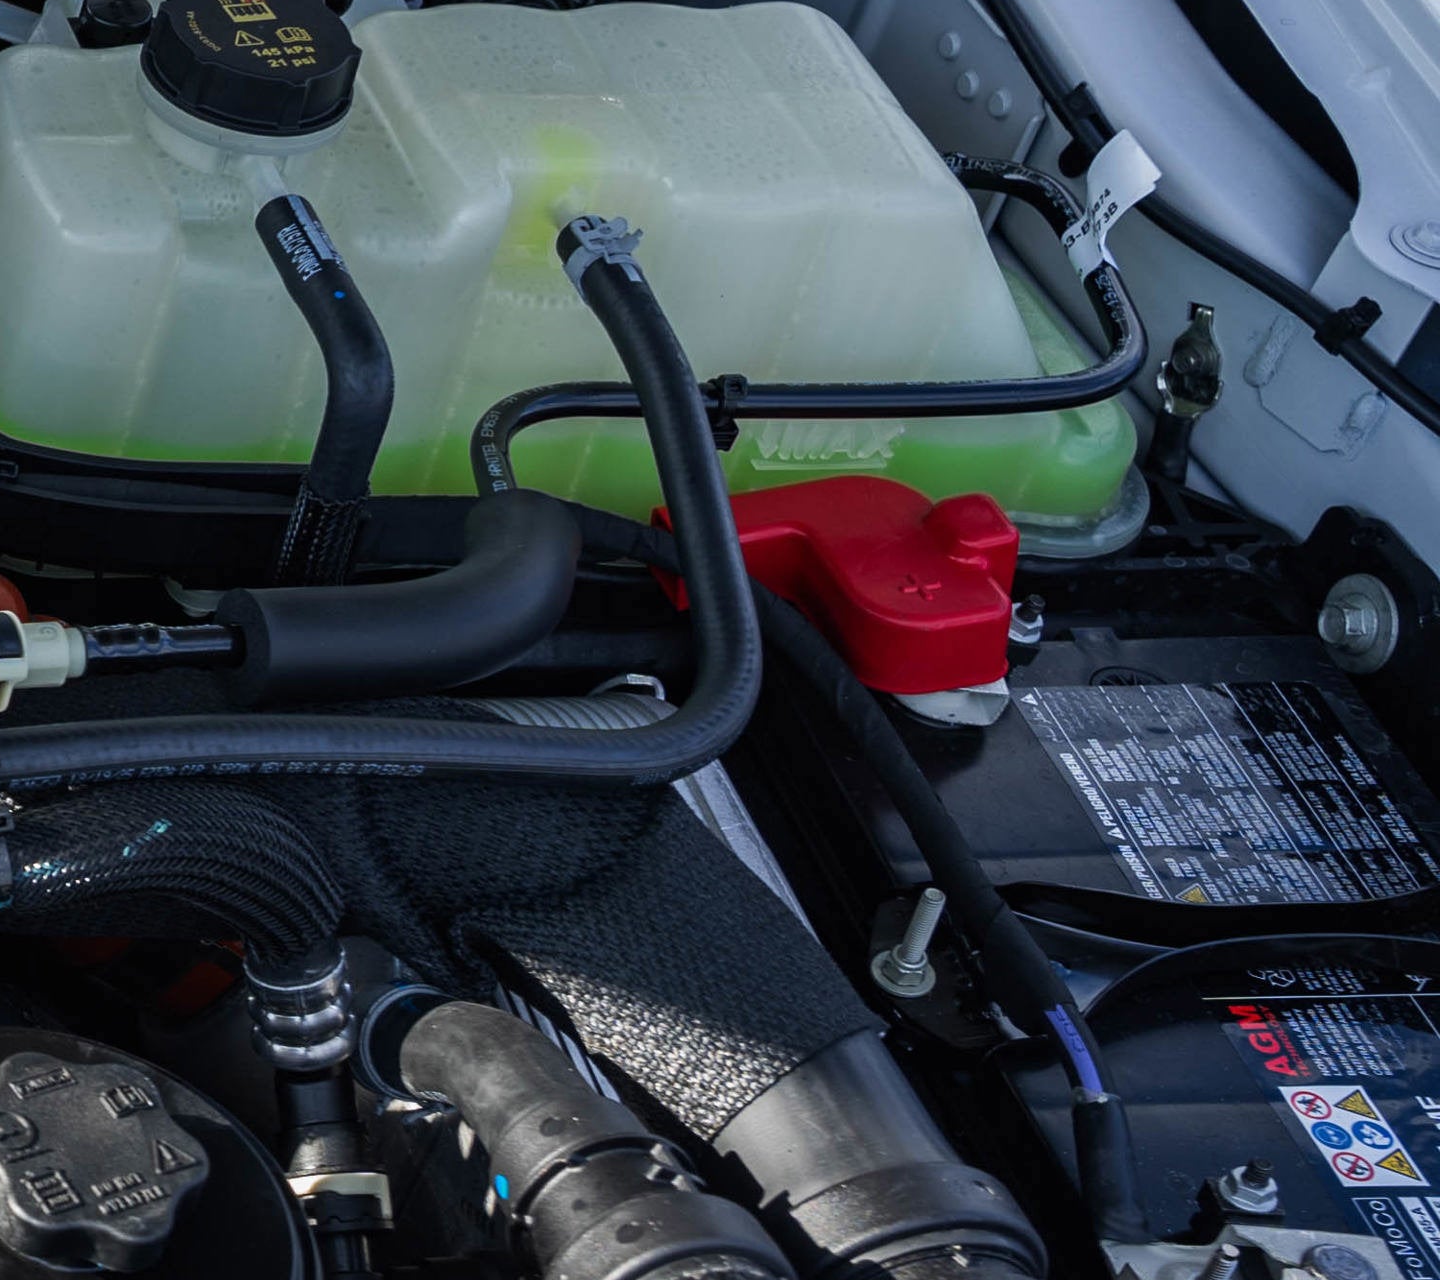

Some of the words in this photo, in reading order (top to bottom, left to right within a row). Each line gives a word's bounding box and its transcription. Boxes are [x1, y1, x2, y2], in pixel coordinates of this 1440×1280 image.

[252, 48, 280, 57] 145
[284, 45, 316, 55] kPa
[294, 56, 316, 66] psi
[1060, 753, 1117, 827] PELIGRO/VENENO
[1228, 1006, 1299, 1076] AGM
[1258, 1005, 1311, 1076] TECHNOLOGY
[1369, 1200, 1433, 1280] FoMoCo
